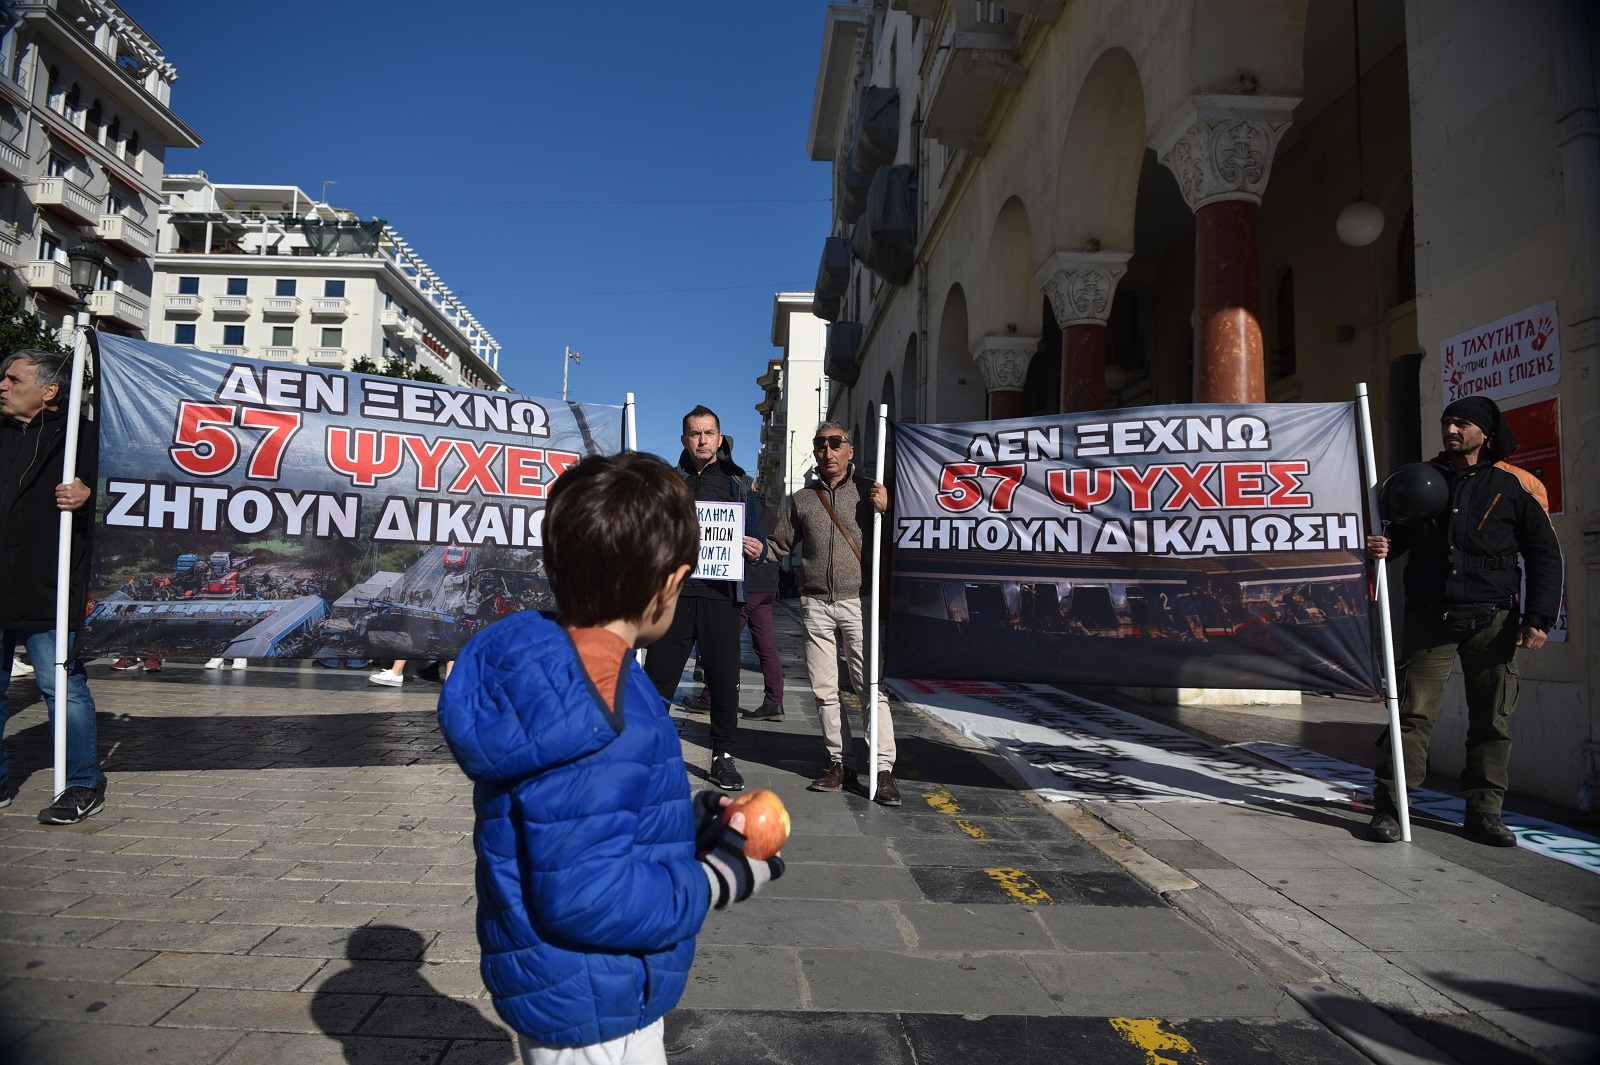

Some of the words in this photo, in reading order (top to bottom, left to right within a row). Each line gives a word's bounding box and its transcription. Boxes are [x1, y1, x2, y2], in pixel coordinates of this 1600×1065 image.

[1462, 319, 1536, 358] ΤΑΧΥΤΗΤΑ
[1491, 344, 1521, 366] ΑΛΛΑ
[1448, 370, 1503, 402] ΣΚΟΤΩΝΕΙ
[1509, 352, 1555, 385] ΕΠΙΣΗΣ
[217, 365, 345, 413] ΔΕΝ
[363, 380, 549, 436] ΞΕΧΝΩ
[169, 400, 302, 480] 57
[968, 427, 1060, 462] ΔΕΝ
[1076, 416, 1269, 457] ΞΕΧΝΩ
[105, 481, 358, 538] ΖΗΤΟΥΝ
[936, 462, 1026, 512] 57
[1047, 460, 1313, 513] ΨΥΧΕΣ
[695, 507, 735, 522] ΚΛΗΜΑ
[897, 518, 1078, 552] ΖΗΤΟΥΝ
[1093, 515, 1359, 553] ΔΙΚΑΙΩΣΗ
[699, 545, 731, 561] ΟΝΤΑΙ
